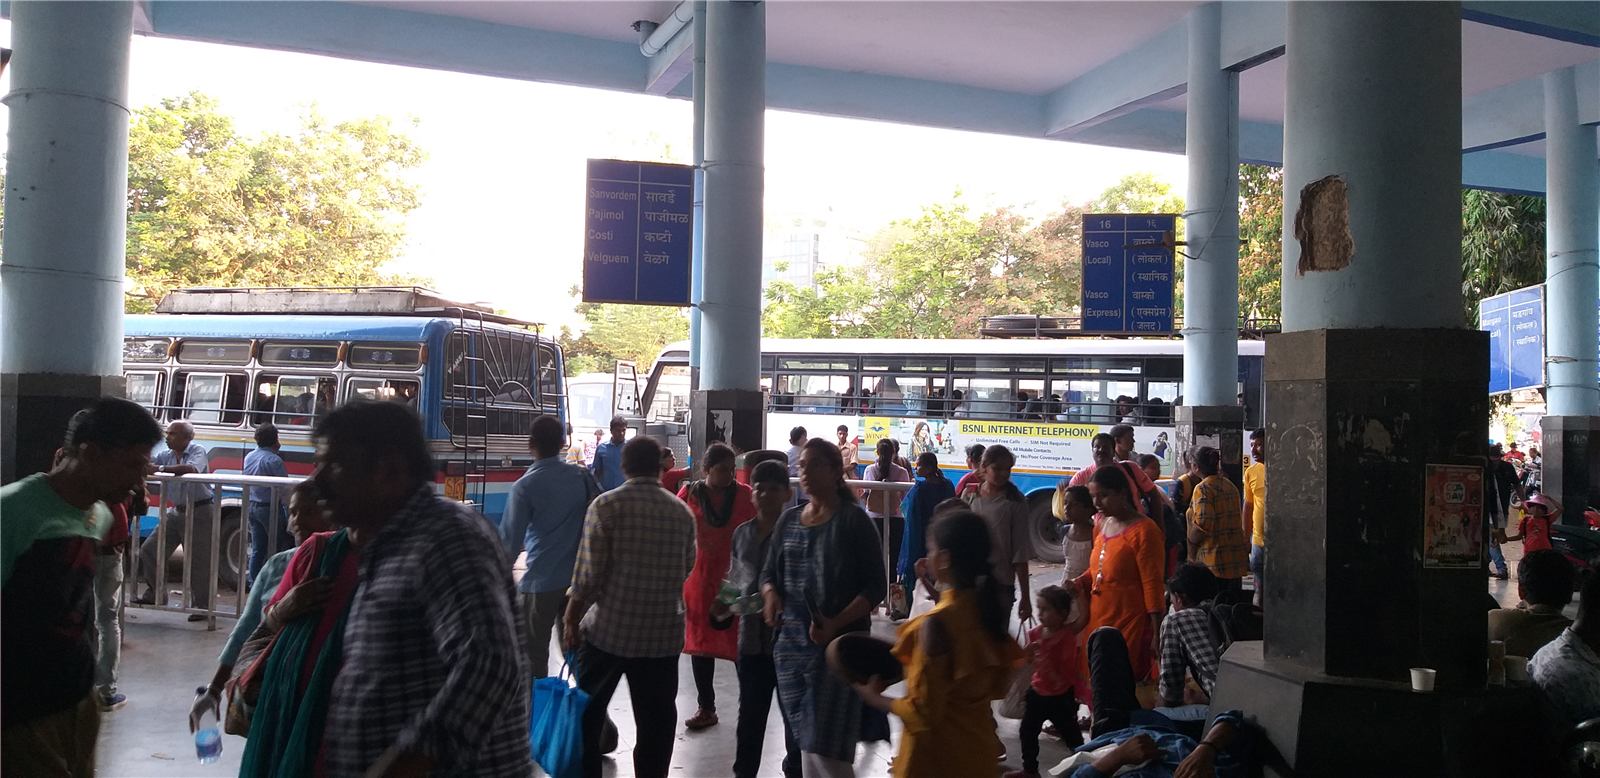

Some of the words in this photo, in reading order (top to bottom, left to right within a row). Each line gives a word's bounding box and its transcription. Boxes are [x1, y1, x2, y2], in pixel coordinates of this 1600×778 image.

[589, 188, 637, 201] Sanvordem
[588, 209, 624, 222] Pajimol
[1099, 220, 1112, 229] 16
[588, 229, 614, 241] Costi
[1085, 239, 1110, 248] Vasco
[588, 249, 629, 265] Velguem
[1085, 256, 1112, 266] (Local)
[1085, 290, 1109, 299] Vasco
[1084, 307, 1121, 319] (Express)
[962, 424, 986, 433] BSNL
[988, 425, 1034, 435] INTERNET
[1036, 426, 1095, 437] TELEPHONY
